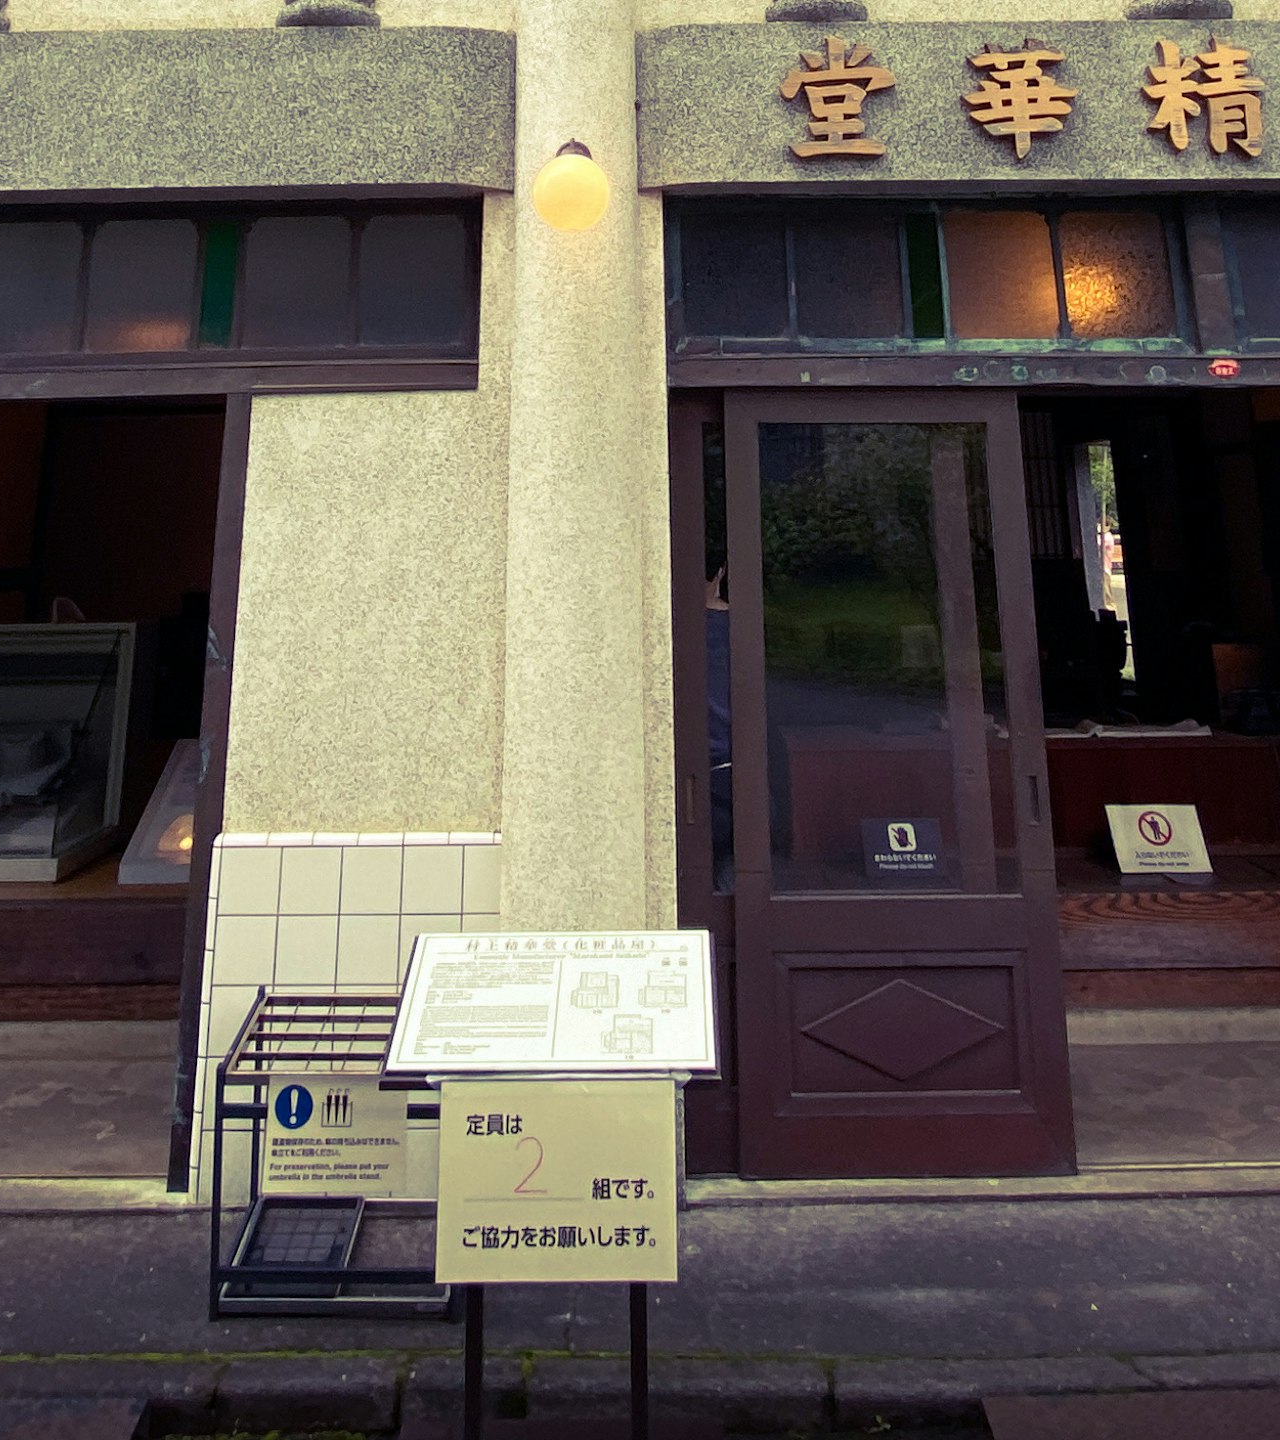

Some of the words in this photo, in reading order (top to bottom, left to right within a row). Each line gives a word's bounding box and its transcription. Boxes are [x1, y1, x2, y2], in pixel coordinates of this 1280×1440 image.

[466, 1114, 523, 1136] 定員は
[514, 1136, 548, 1194] 2
[591, 1178, 654, 1200] 組です。
[462, 1225, 656, 1249] ご協力をお願いします。
